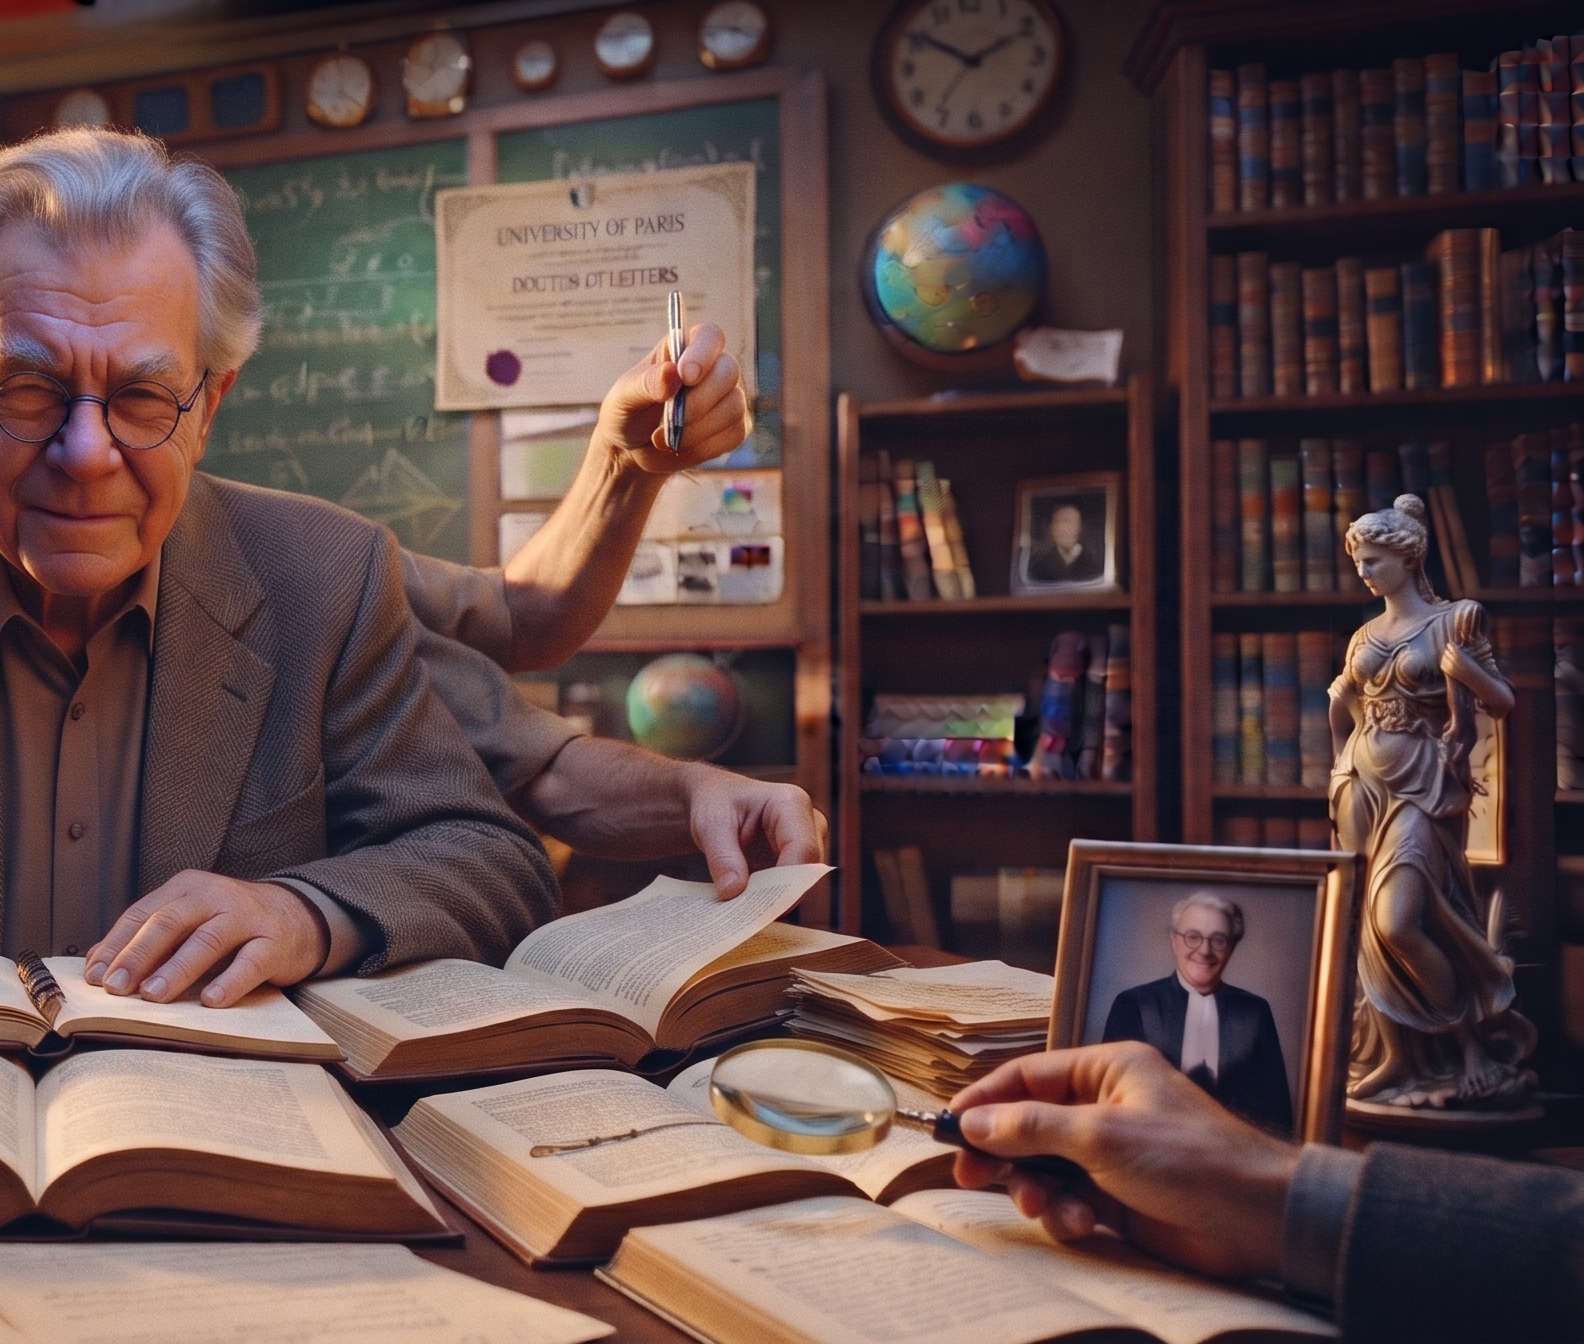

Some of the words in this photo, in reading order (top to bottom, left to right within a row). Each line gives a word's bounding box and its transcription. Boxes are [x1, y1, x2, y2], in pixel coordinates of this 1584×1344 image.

[497, 220, 601, 246] UNIVERSITY
[606, 217, 629, 236] OF
[635, 213, 686, 235] PARIS
[610, 265, 680, 288] LETTERS
